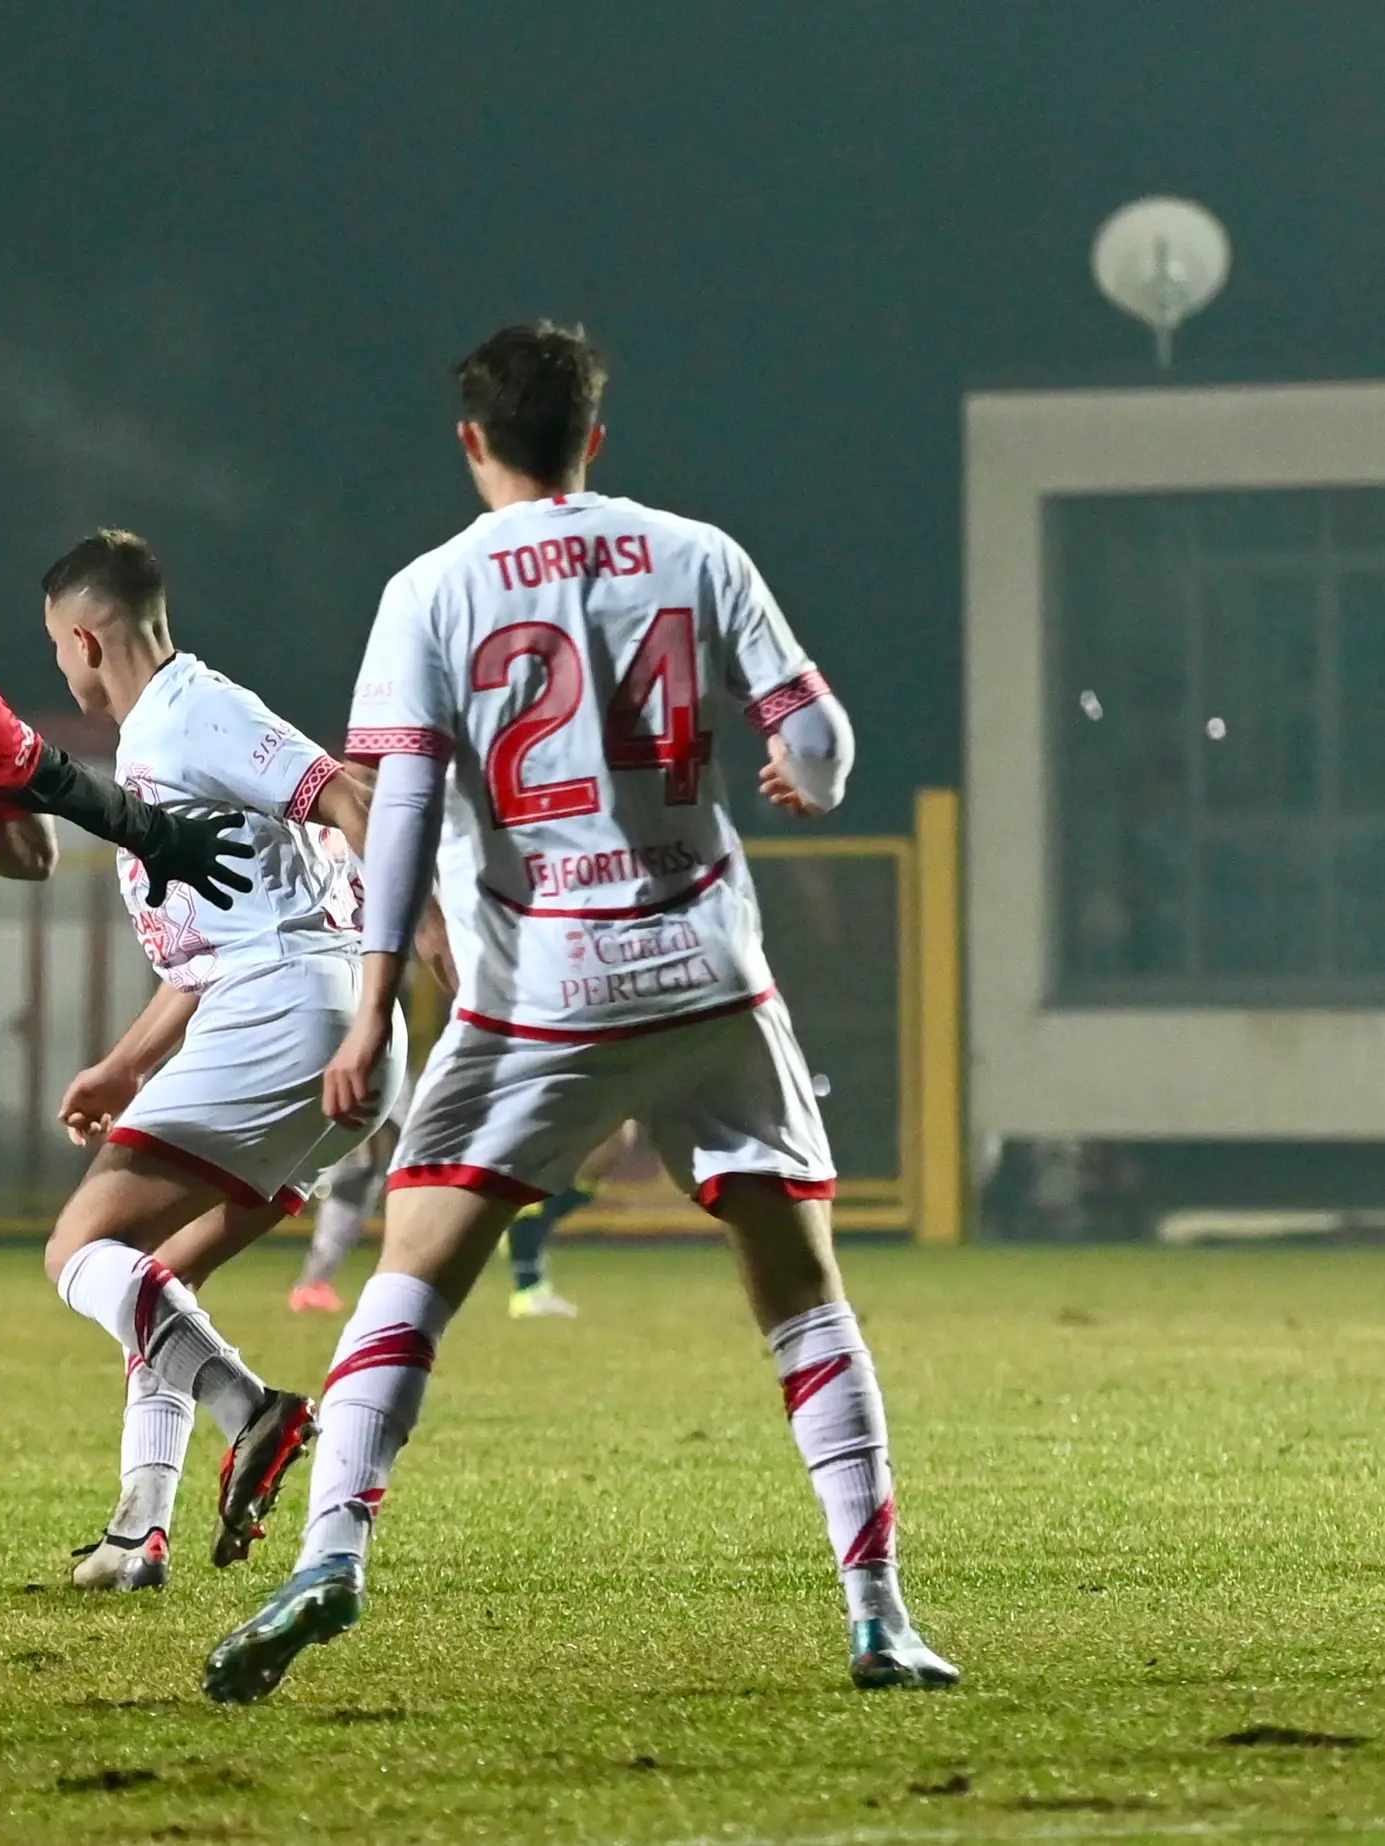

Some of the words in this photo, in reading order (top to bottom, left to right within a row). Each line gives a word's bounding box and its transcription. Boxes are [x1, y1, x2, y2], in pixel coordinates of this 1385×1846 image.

[489, 534, 653, 592] TORRASI
[471, 607, 712, 830] 24
[559, 958, 720, 1009] PERUGIA
